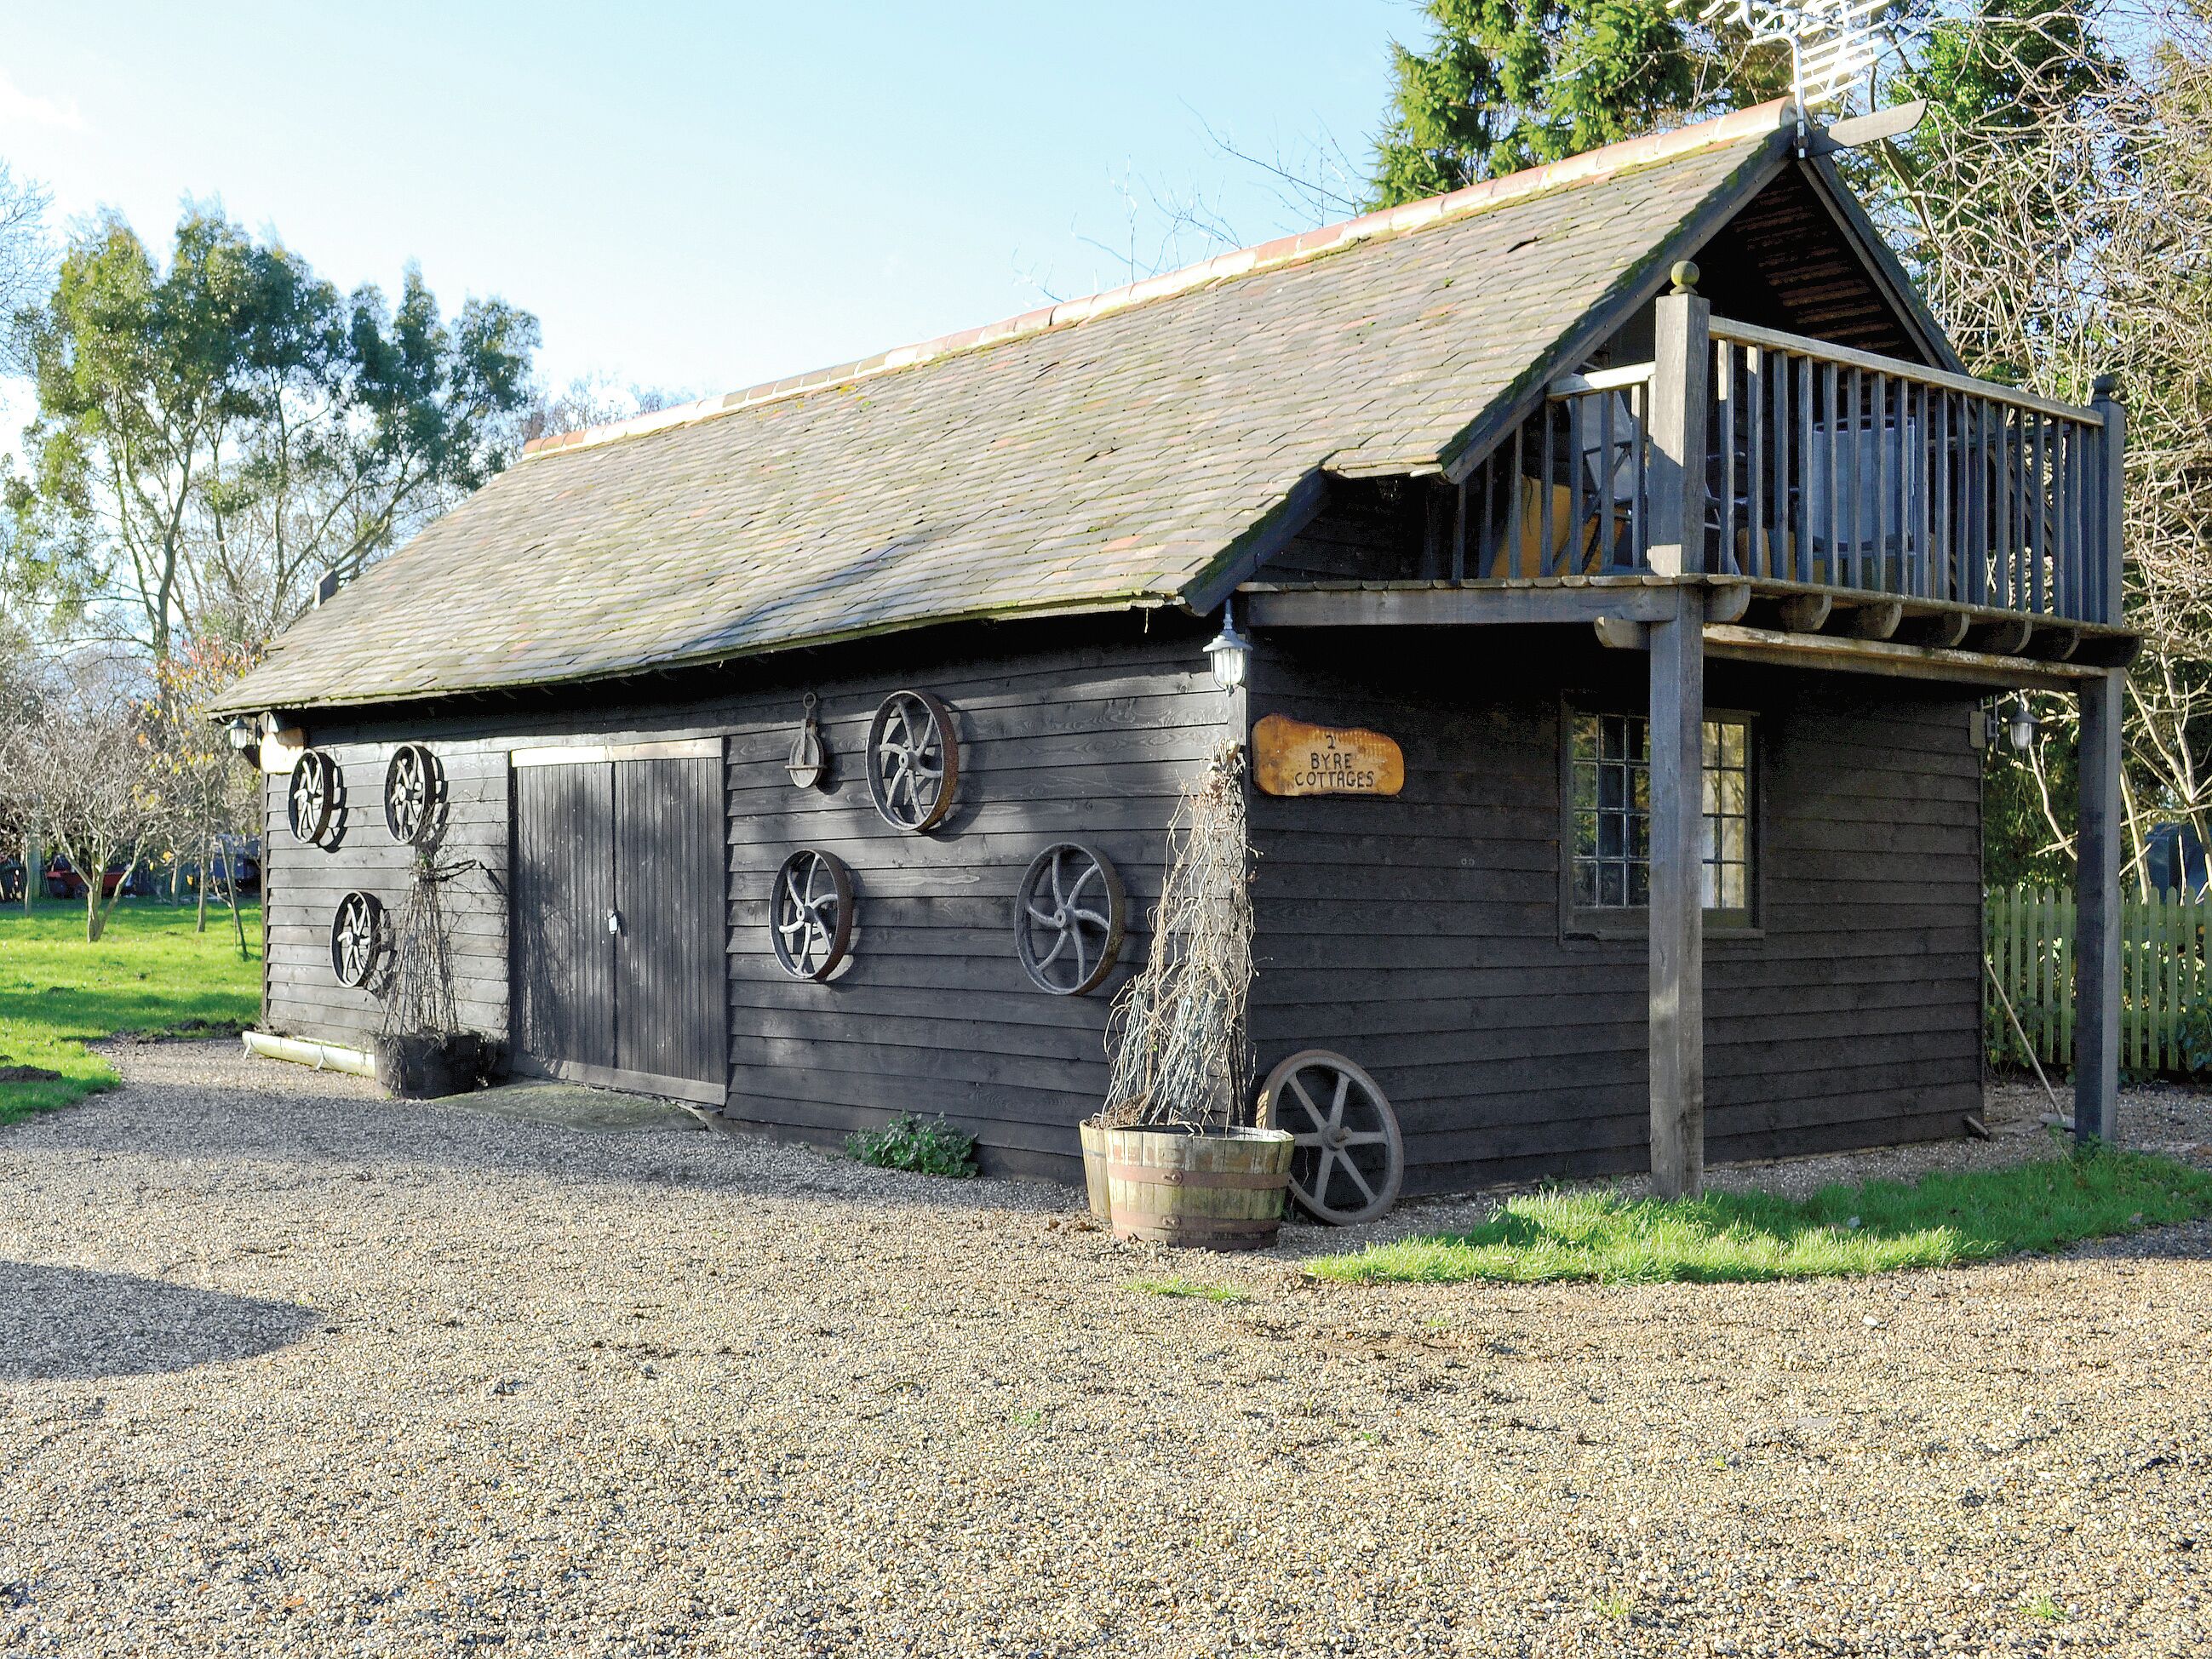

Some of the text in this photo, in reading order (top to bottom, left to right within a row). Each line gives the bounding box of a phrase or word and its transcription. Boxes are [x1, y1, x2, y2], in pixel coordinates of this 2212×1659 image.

[1326, 735, 1336, 749] 2
[1311, 752, 1352, 769] BYRE
[1295, 771, 1374, 788] COTTAGES
